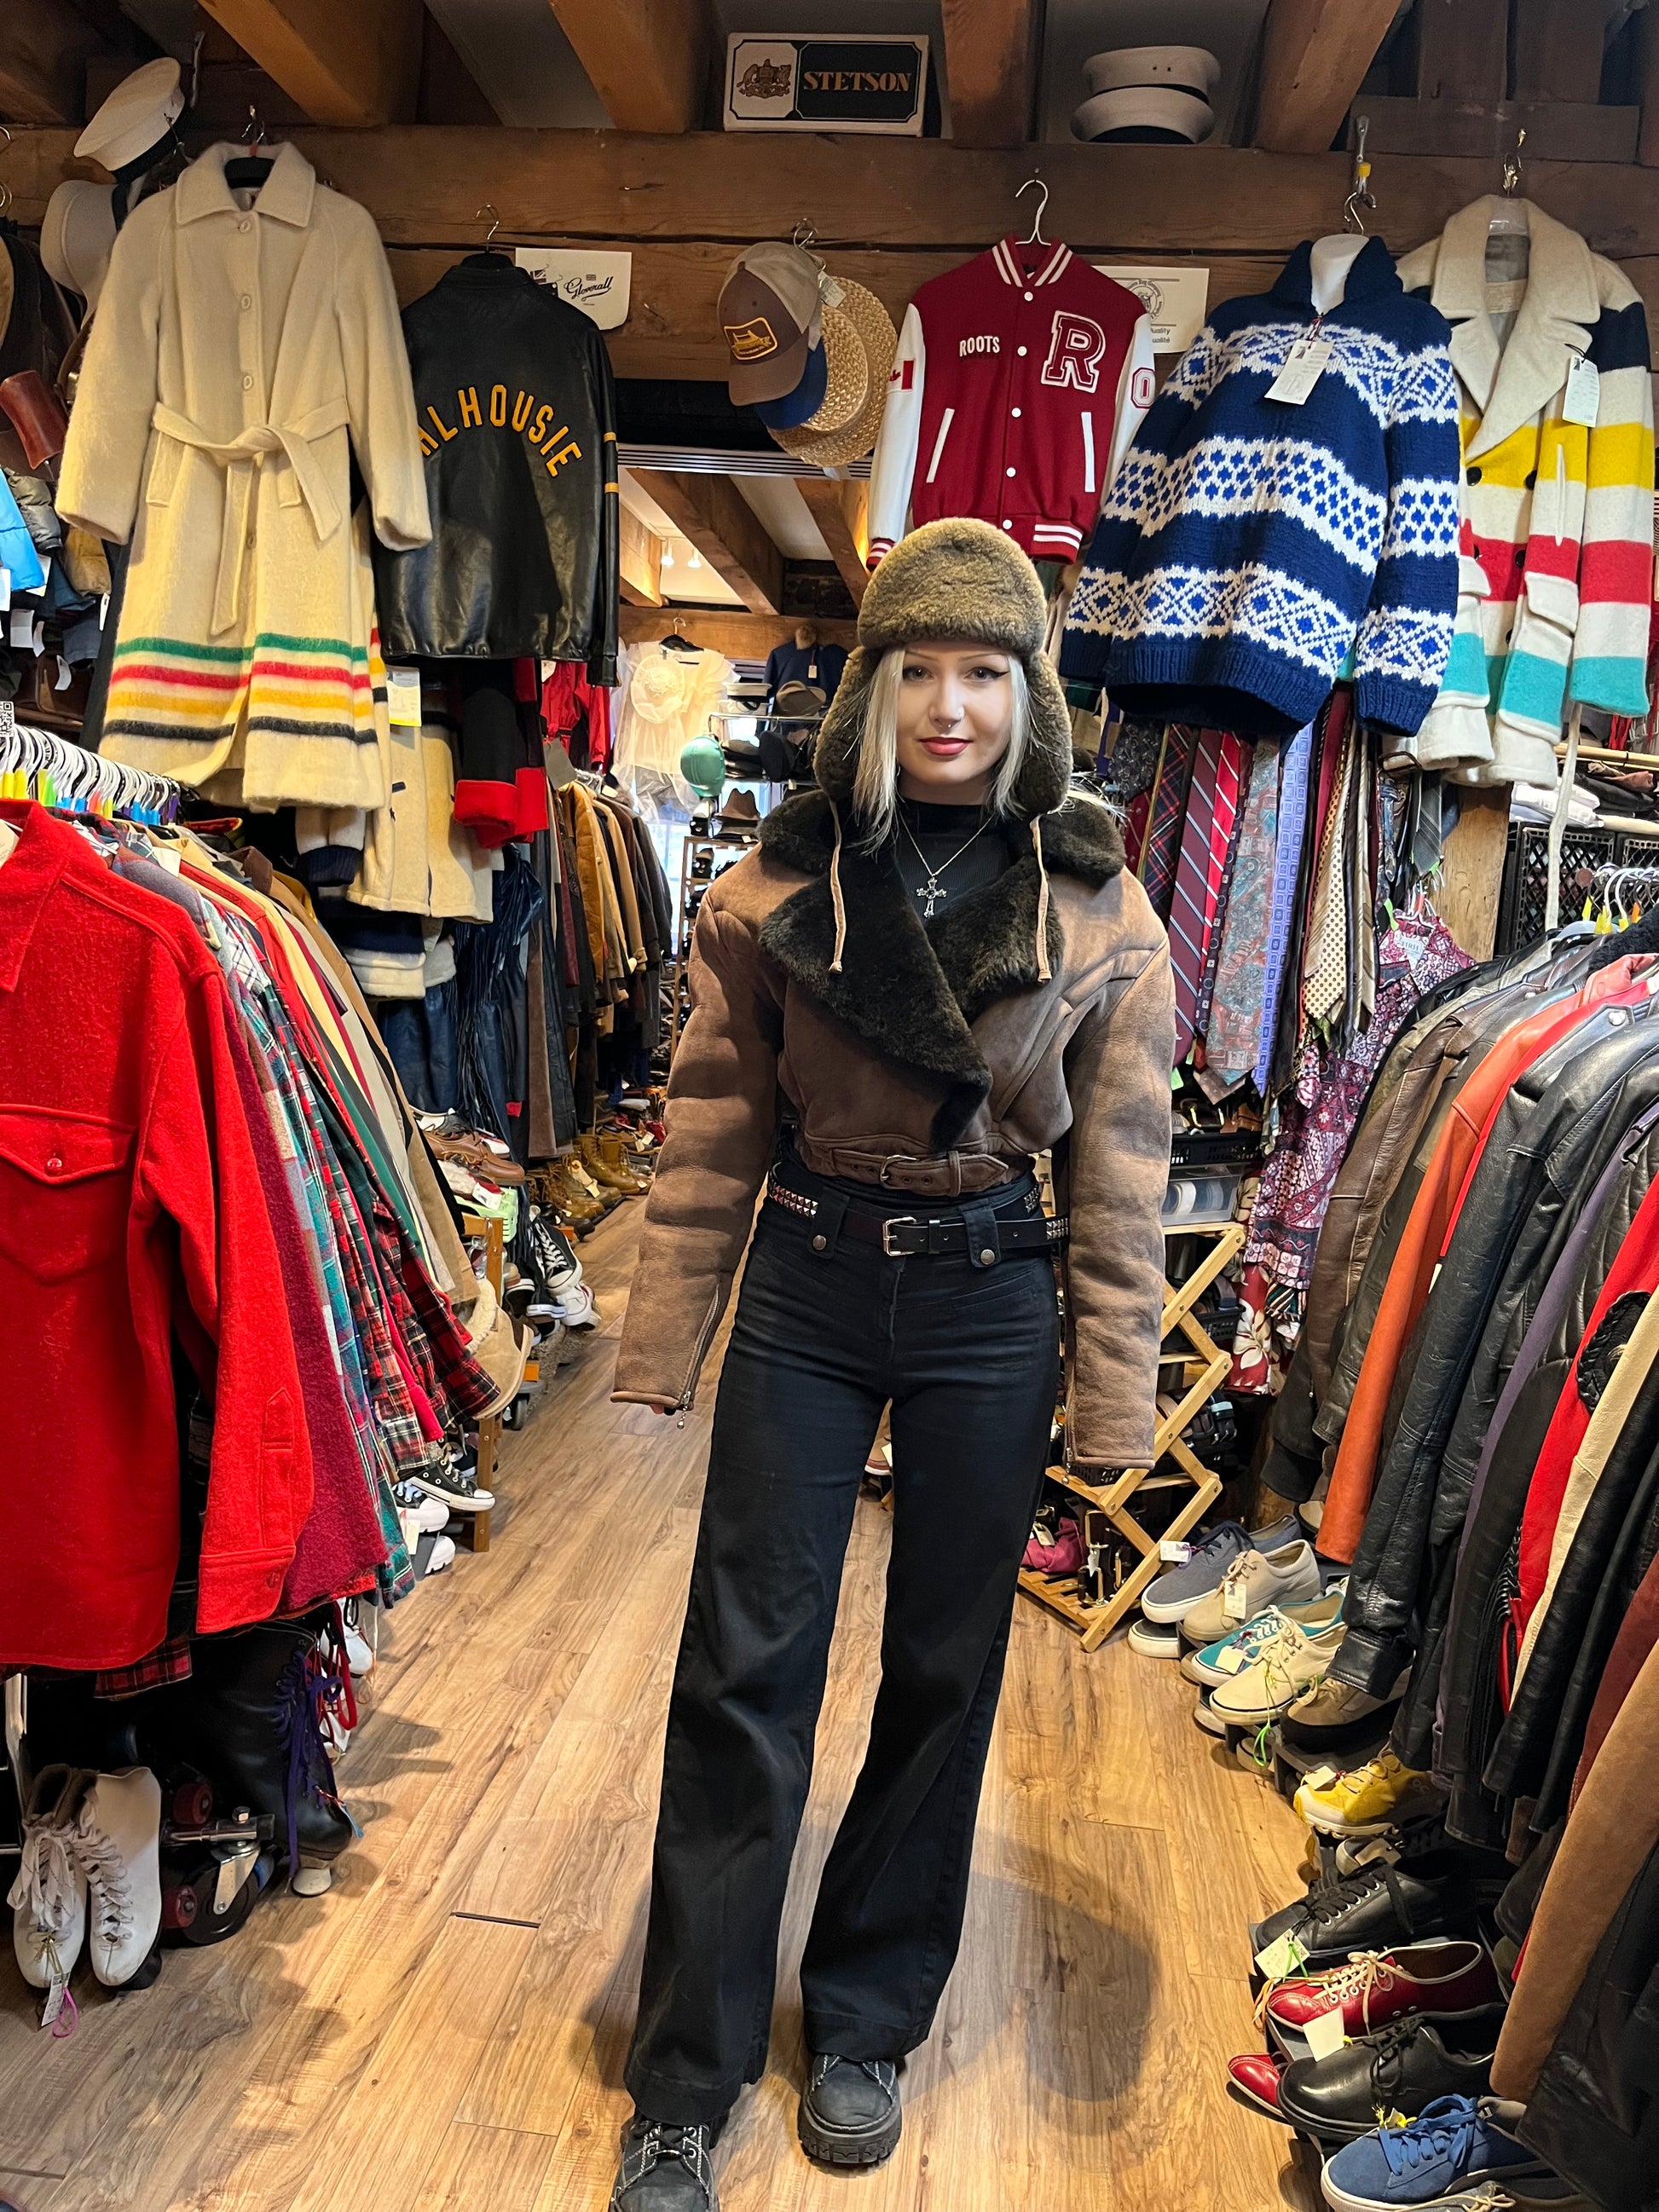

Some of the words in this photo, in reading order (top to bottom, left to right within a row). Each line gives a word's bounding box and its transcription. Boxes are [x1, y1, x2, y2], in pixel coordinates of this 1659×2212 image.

[803, 71, 912, 93] STETSON
[564, 276, 614, 300] Gloverall
[959, 335, 1000, 357] ROOTS
[1041, 309, 1106, 394] R
[417, 384, 582, 477] ALHOUSIE
